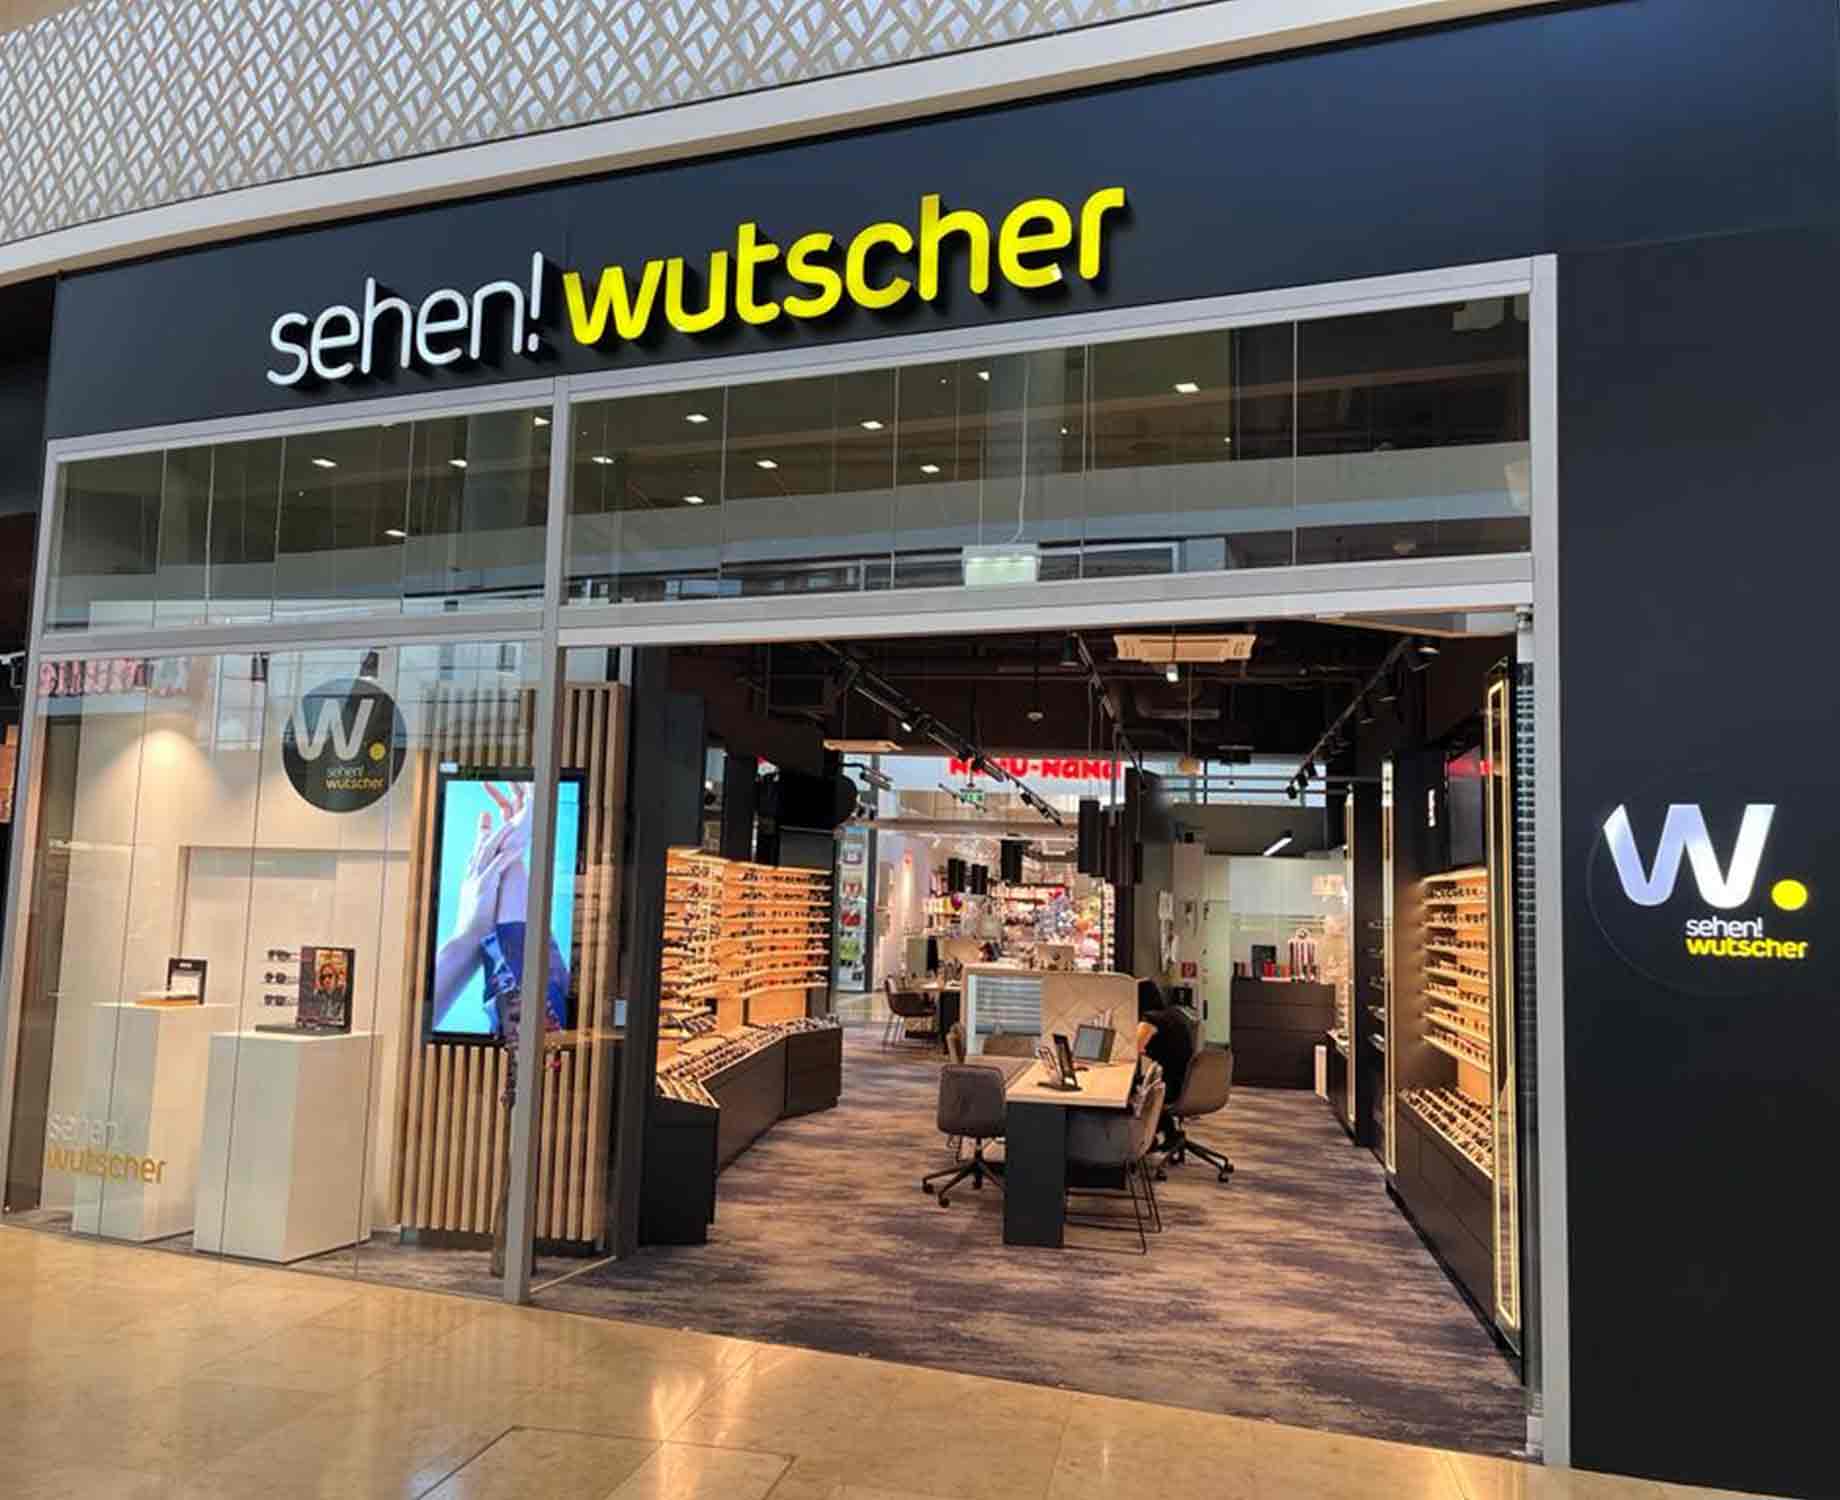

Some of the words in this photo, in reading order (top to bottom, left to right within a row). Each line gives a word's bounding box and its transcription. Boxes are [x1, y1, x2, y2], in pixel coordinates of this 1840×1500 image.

[267, 251, 542, 386] sehen!
[563, 187, 1124, 344] wutscher
[326, 777, 384, 790] wutscher
[1685, 916, 1764, 938] sehen!
[1685, 938, 1808, 959] wutscher
[47, 1145, 167, 1184] wutscher
